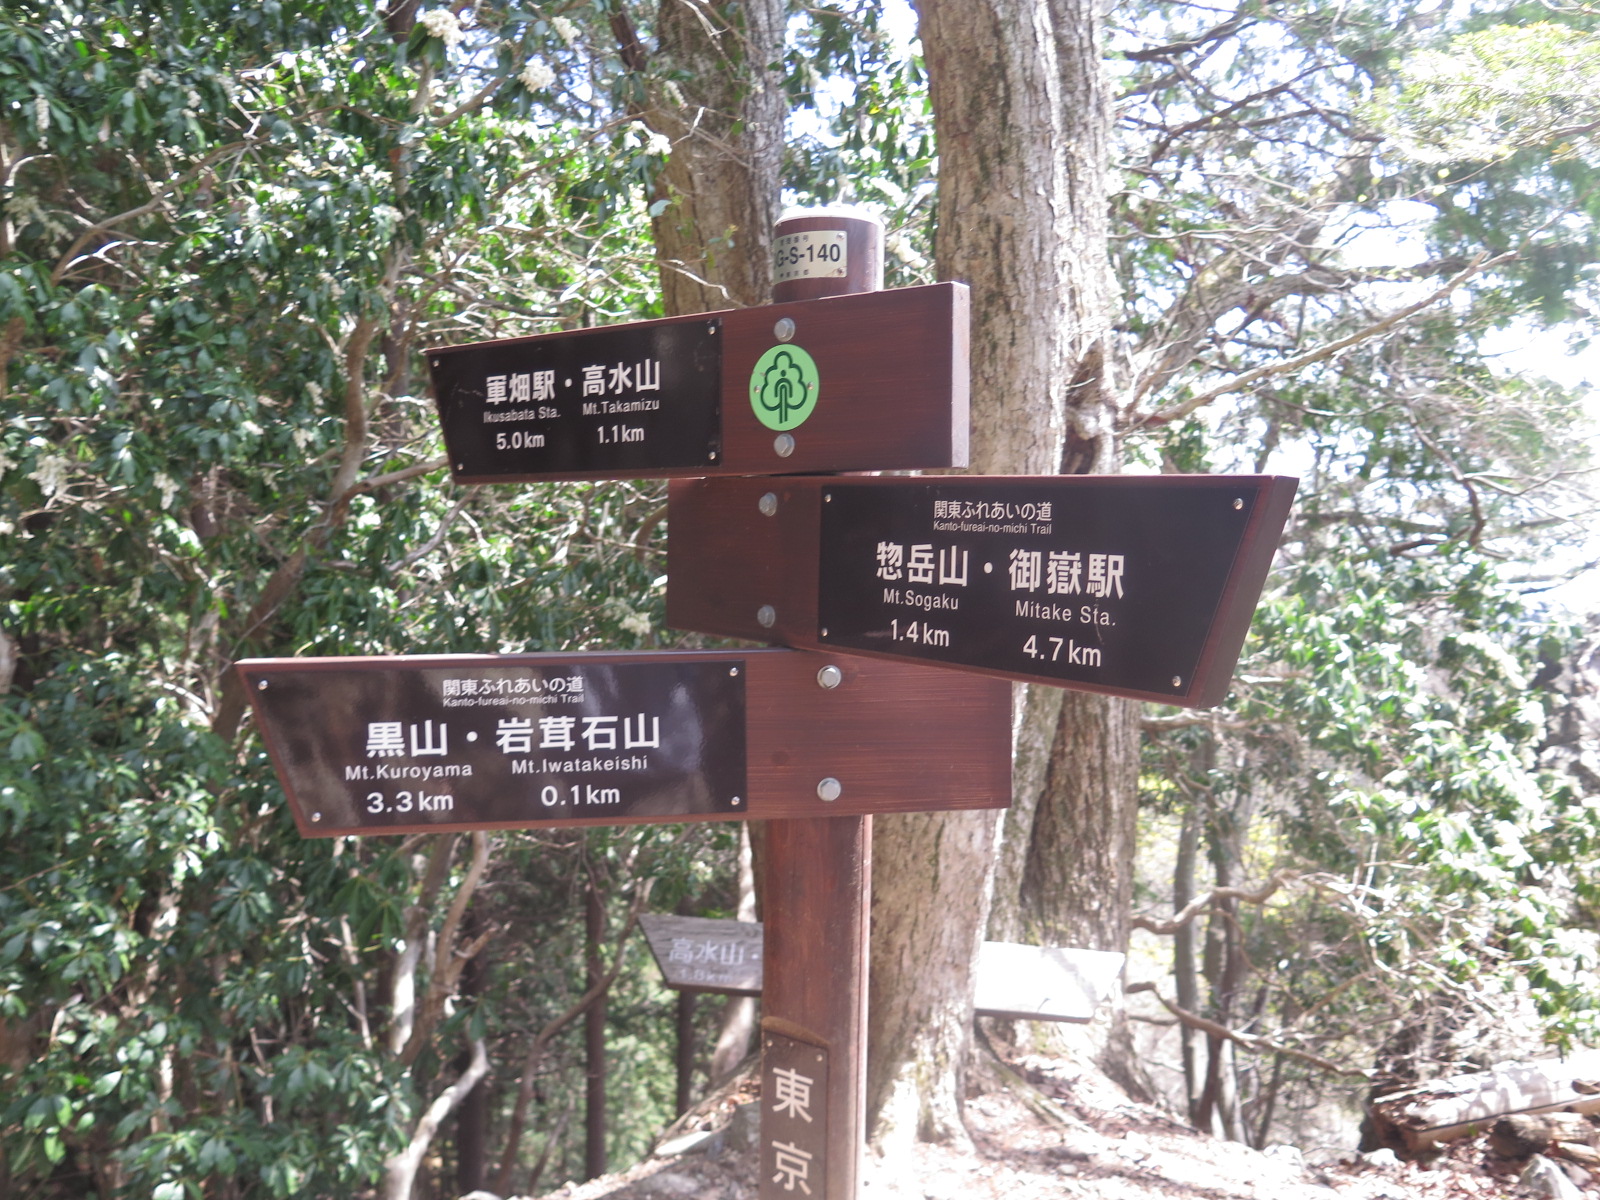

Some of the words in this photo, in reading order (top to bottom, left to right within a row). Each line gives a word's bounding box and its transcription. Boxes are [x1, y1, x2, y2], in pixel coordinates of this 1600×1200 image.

[774, 243, 841, 270] G-S-140
[484, 358, 661, 406] 軍畑駅・高水山
[483, 411, 536, 423] Ikusabata
[538, 406, 562, 419] Sta.
[582, 399, 660, 416] Mt.Takamizu
[933, 500, 1052, 521] 関東ふれあいの道
[933, 520, 1028, 534] Kanto-fureai-no-michi
[1030, 523, 1052, 535] Trail
[883, 588, 959, 612] Mt.Sogaku
[1015, 600, 1072, 622] Mitake
[1080, 605, 1116, 627] Sta.
[442, 676, 584, 697] 関東ふれあいの道
[443, 695, 558, 708] Kanto-fureai-no-michi
[561, 693, 585, 704] Trail
[365, 713, 660, 759] 黒山・岩茸石山
[345, 764, 473, 782] Mt.Kuroyama
[511, 755, 648, 775] Mt.Iwatakeishi
